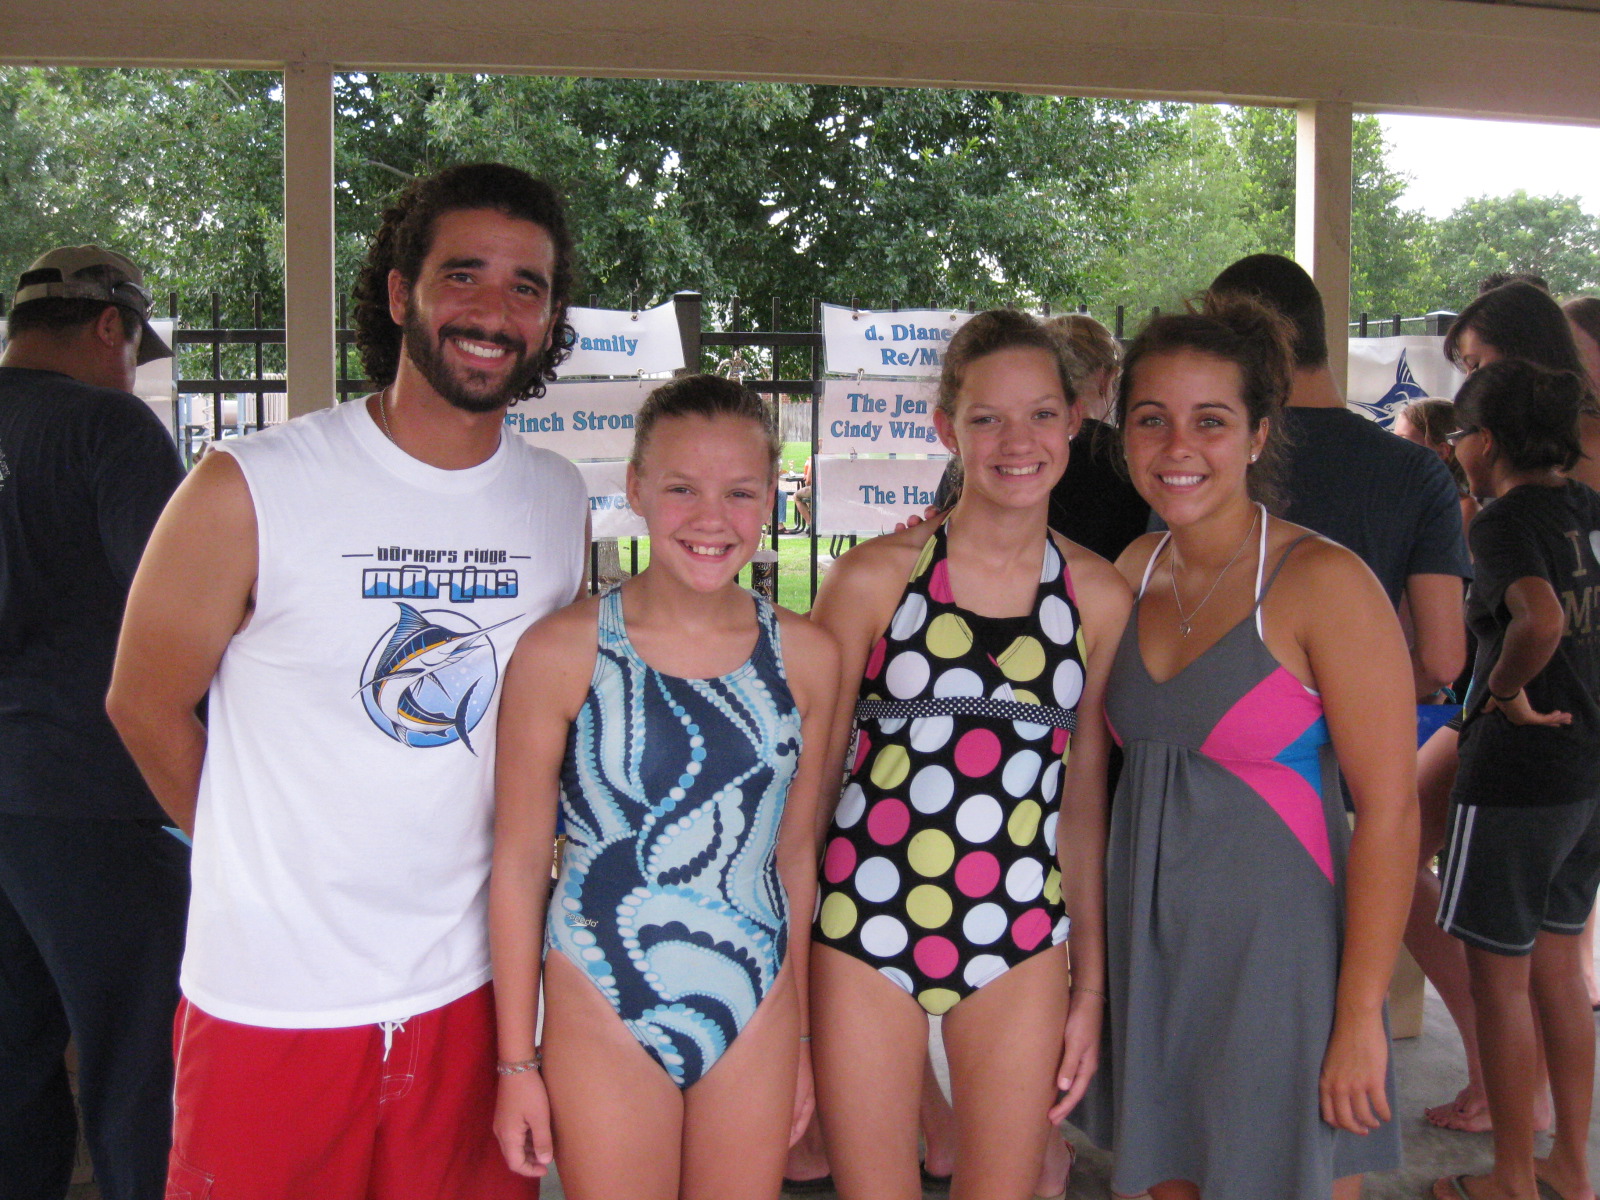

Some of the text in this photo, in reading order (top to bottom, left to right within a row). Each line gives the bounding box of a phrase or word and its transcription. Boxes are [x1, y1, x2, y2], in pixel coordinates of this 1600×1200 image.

[865, 323, 953, 341] d. Diane
[881, 347, 944, 367] Re/M
[847, 393, 927, 418] The Jen
[504, 410, 635, 432] Finch Stron
[830, 420, 938, 443] Cindy Wing
[859, 485, 896, 504] The
[464, 548, 507, 565] ridge
[1562, 530, 1587, 577] I
[362, 565, 518, 603] marlins
